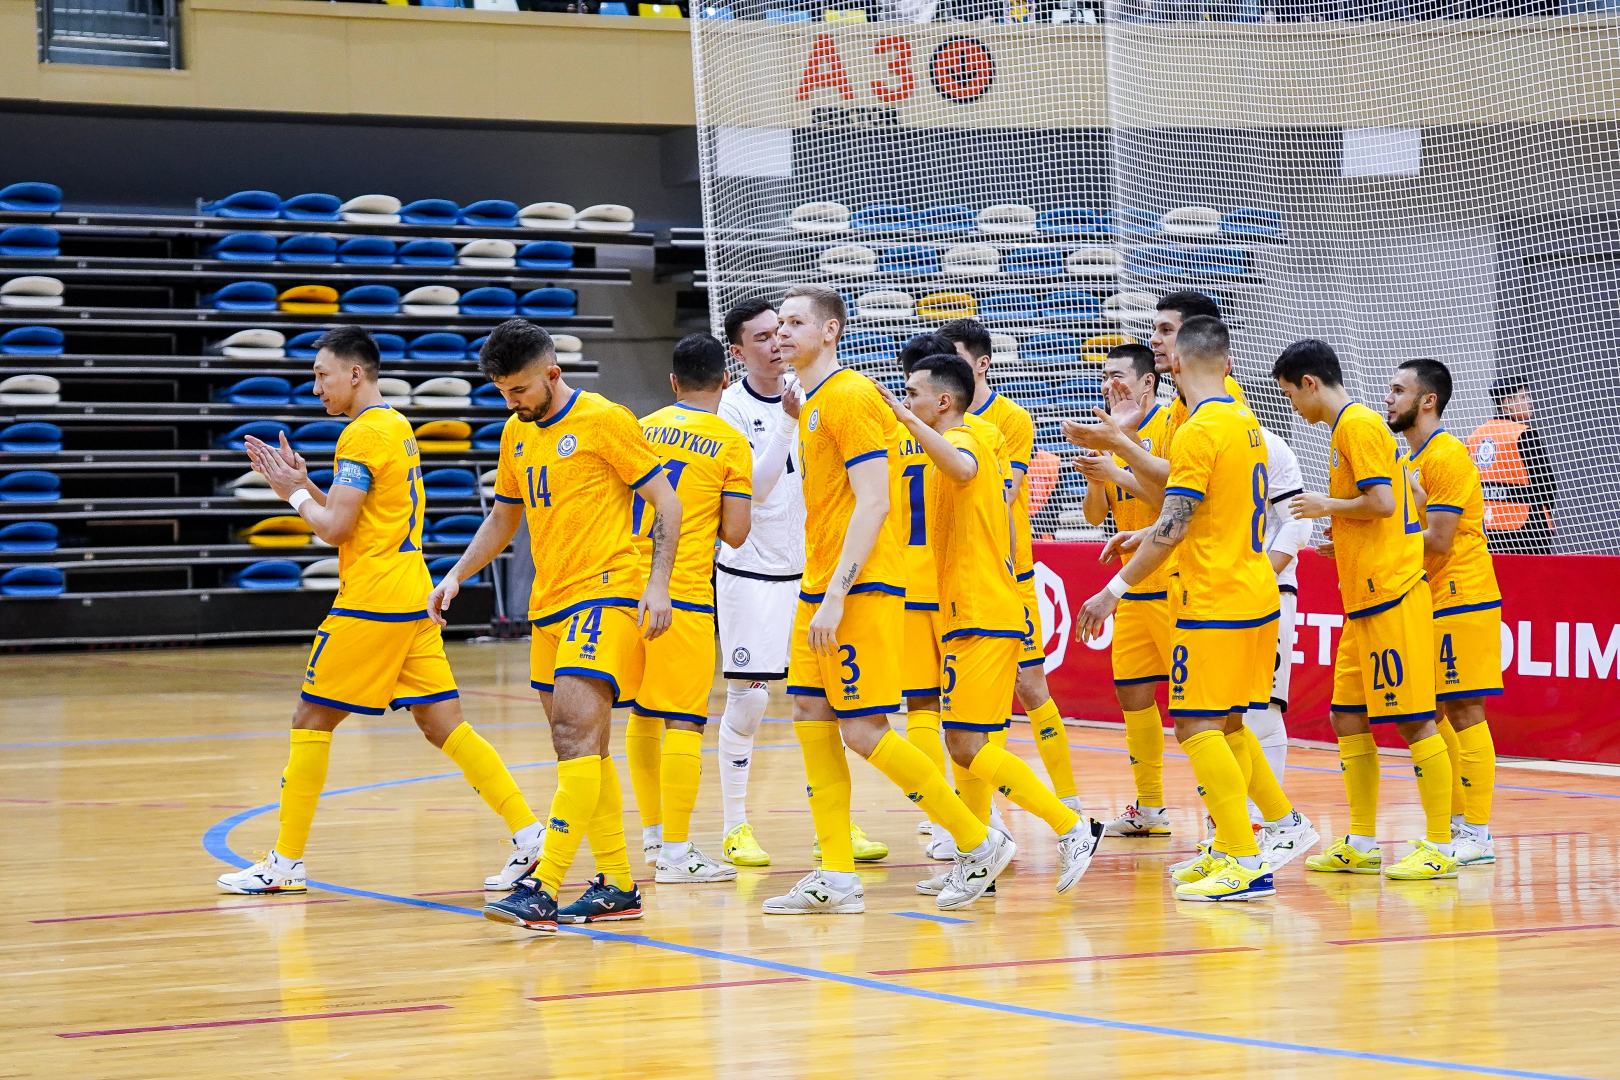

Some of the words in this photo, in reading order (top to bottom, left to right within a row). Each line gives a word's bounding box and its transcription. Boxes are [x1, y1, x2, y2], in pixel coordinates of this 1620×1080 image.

[641, 427, 723, 458] GYNDYKOV
[526, 465, 552, 508] 14
[1251, 462, 1268, 553] 8
[566, 607, 603, 644] 14
[308, 630, 332, 668] 7
[838, 644, 861, 685] 3
[1171, 645, 1189, 684] 8
[1439, 634, 1458, 670] 4
[942, 654, 957, 694] 5
[1370, 649, 1404, 691] 20
